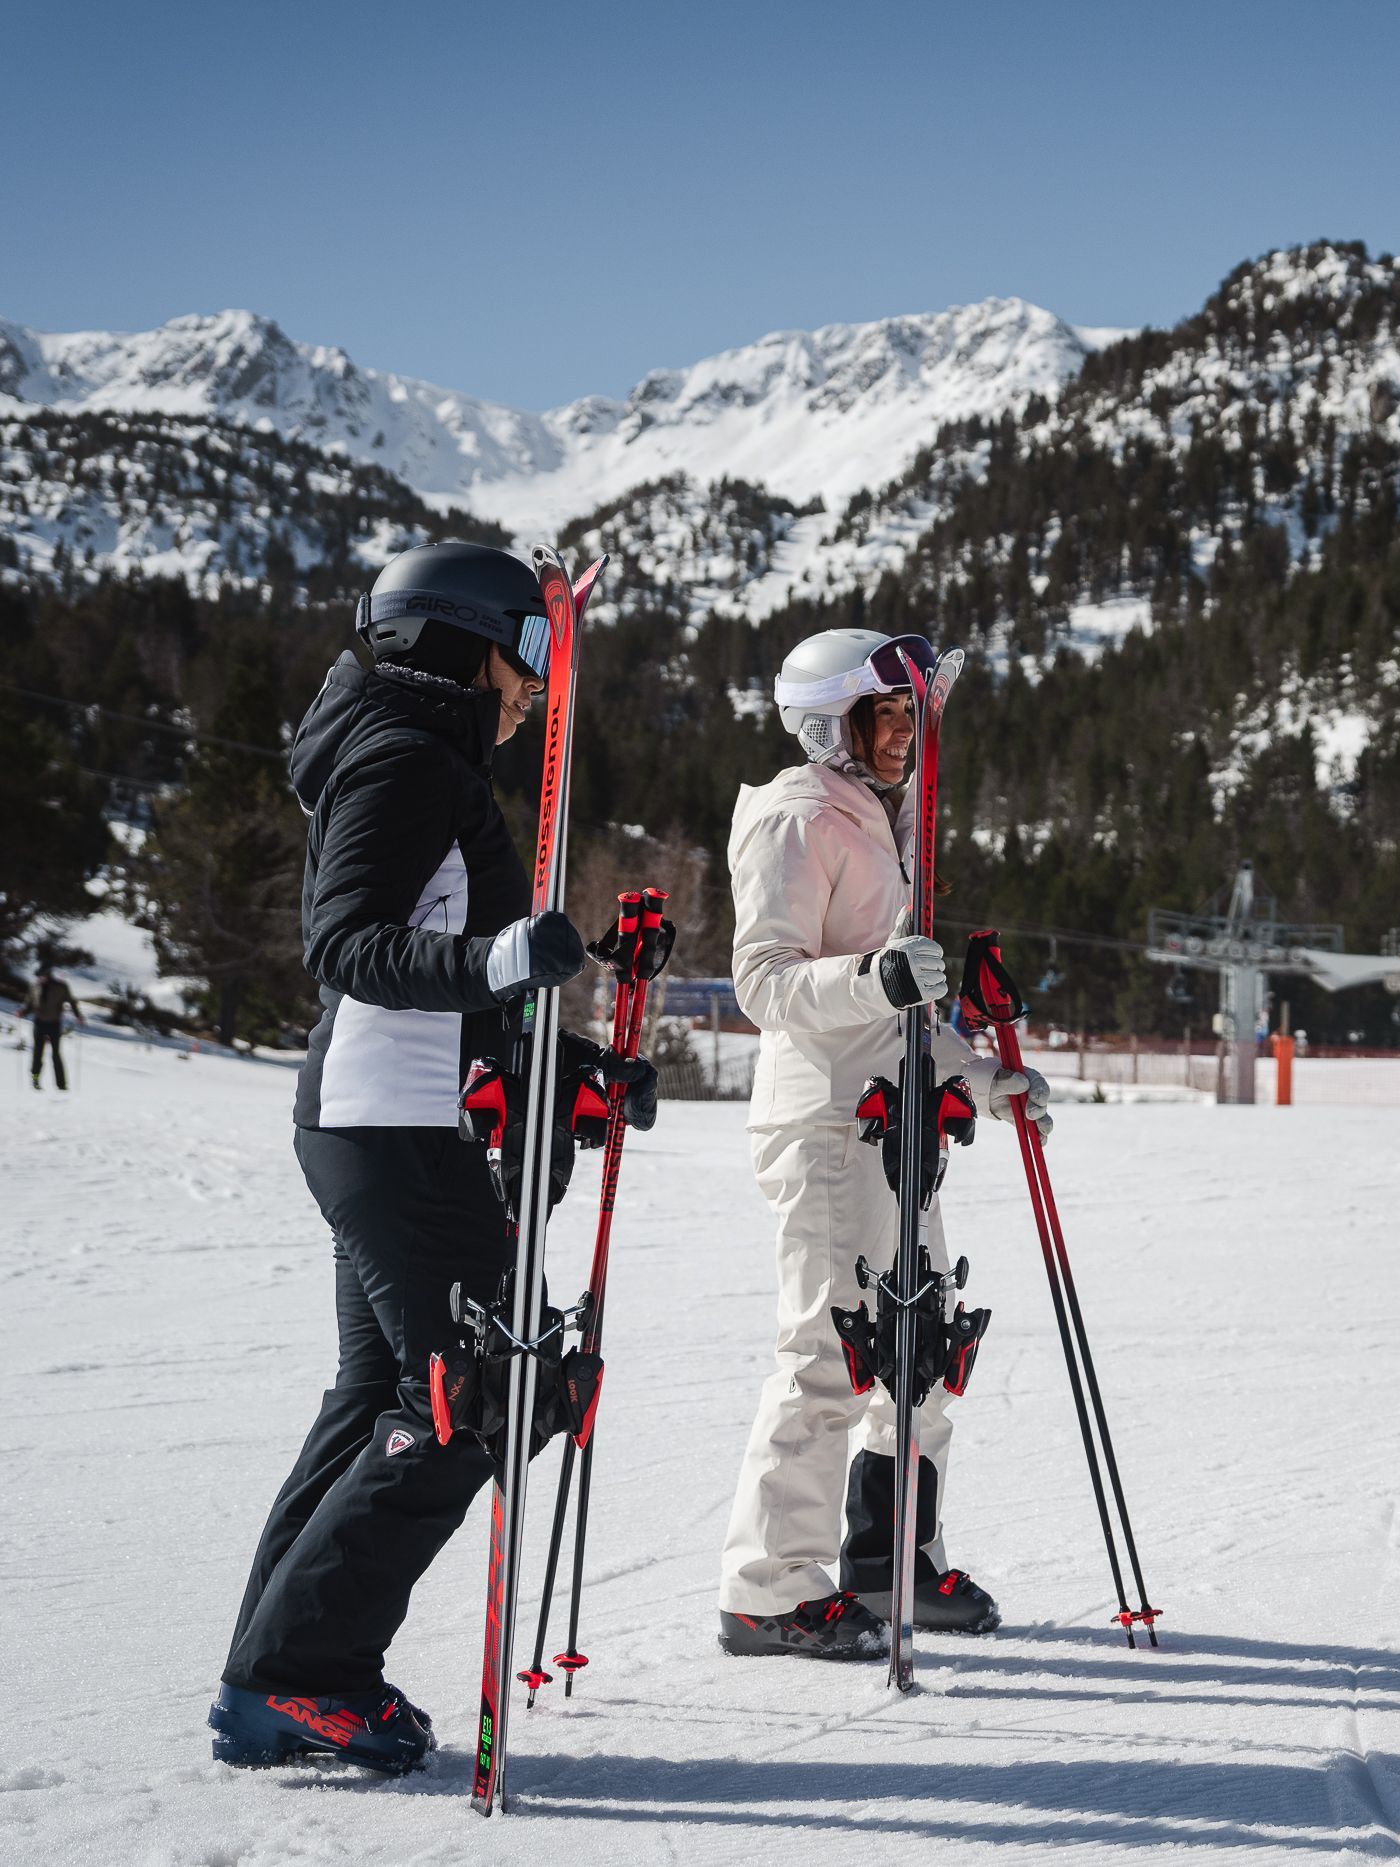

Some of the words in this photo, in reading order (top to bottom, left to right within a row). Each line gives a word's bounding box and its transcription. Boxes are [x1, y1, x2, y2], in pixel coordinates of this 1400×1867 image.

[405, 595, 478, 622] GIRO
[537, 694, 561, 889] ROSSIGNOL
[567, 1378, 578, 1403] LOOK
[265, 1694, 353, 1747] LANGE
